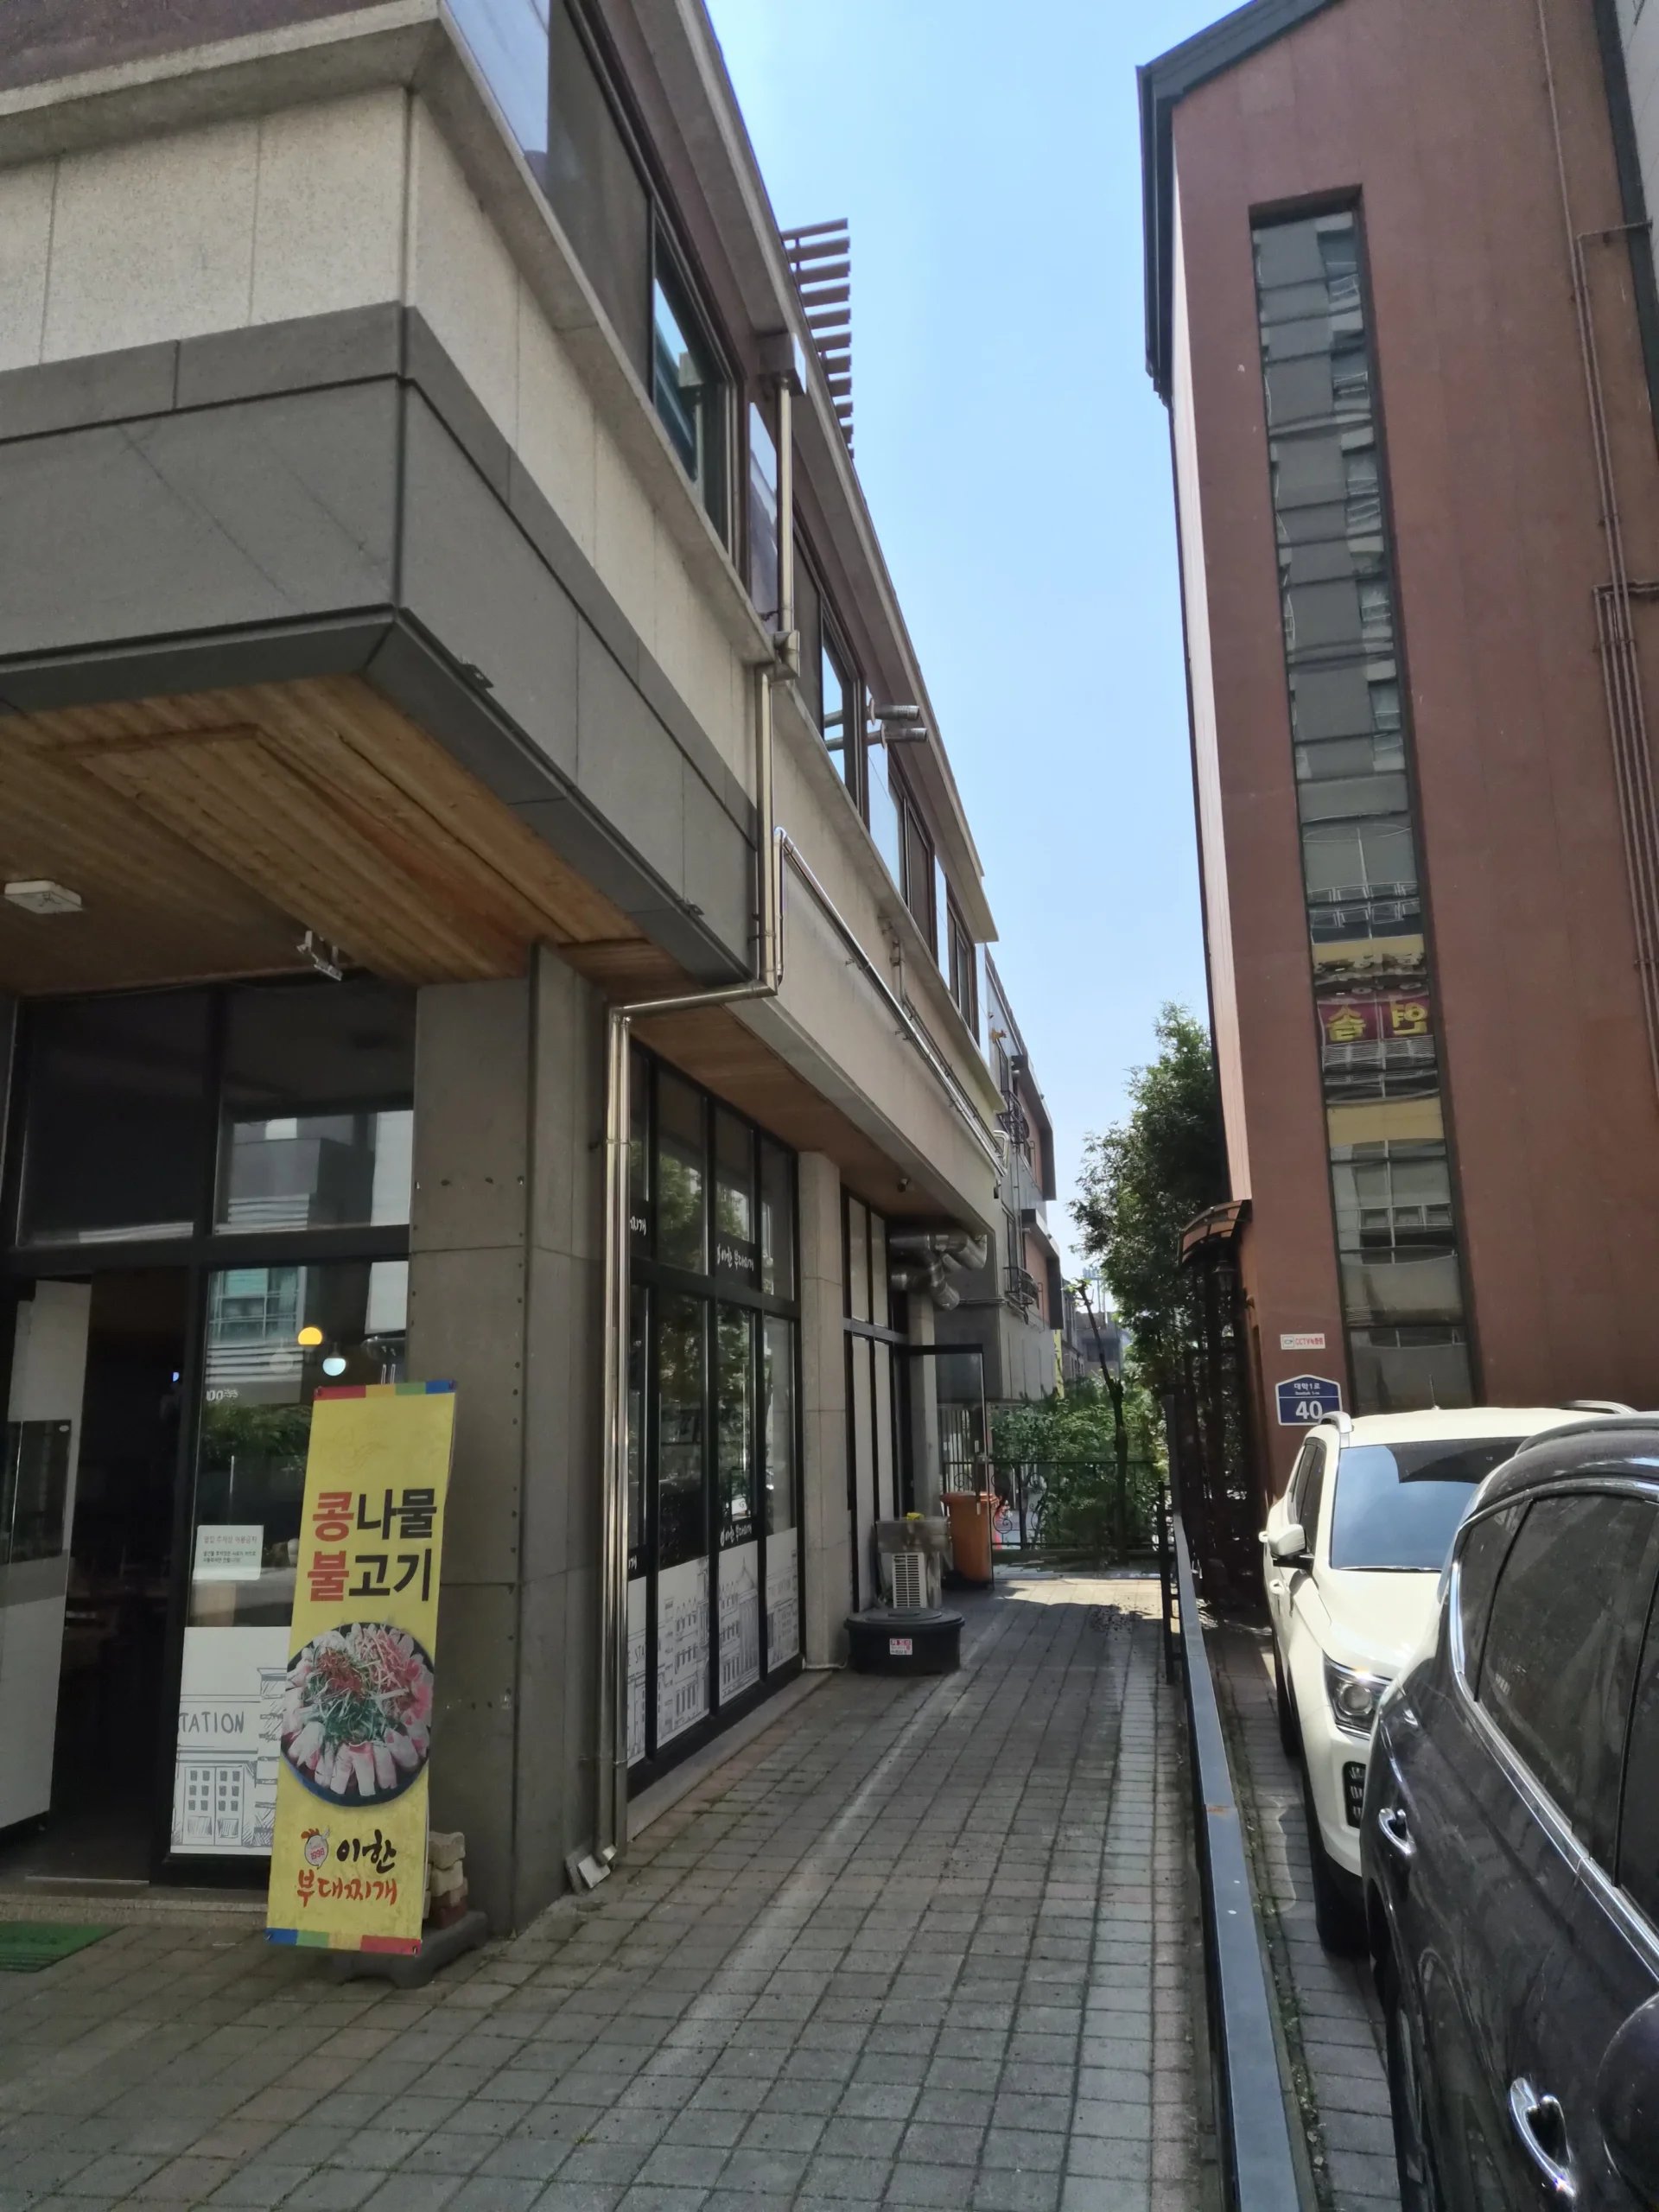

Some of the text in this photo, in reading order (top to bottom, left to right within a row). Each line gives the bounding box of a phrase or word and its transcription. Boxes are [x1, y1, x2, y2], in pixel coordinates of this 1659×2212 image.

[1295, 1400, 1323, 1420] 40
[313, 1488, 438, 1541] 콩나물
[308, 1548, 432, 1601] 불고기
[179, 1711, 245, 1734] TATION
[336, 1828, 397, 1874] 이한
[297, 1868, 397, 1908] 부대찌개
